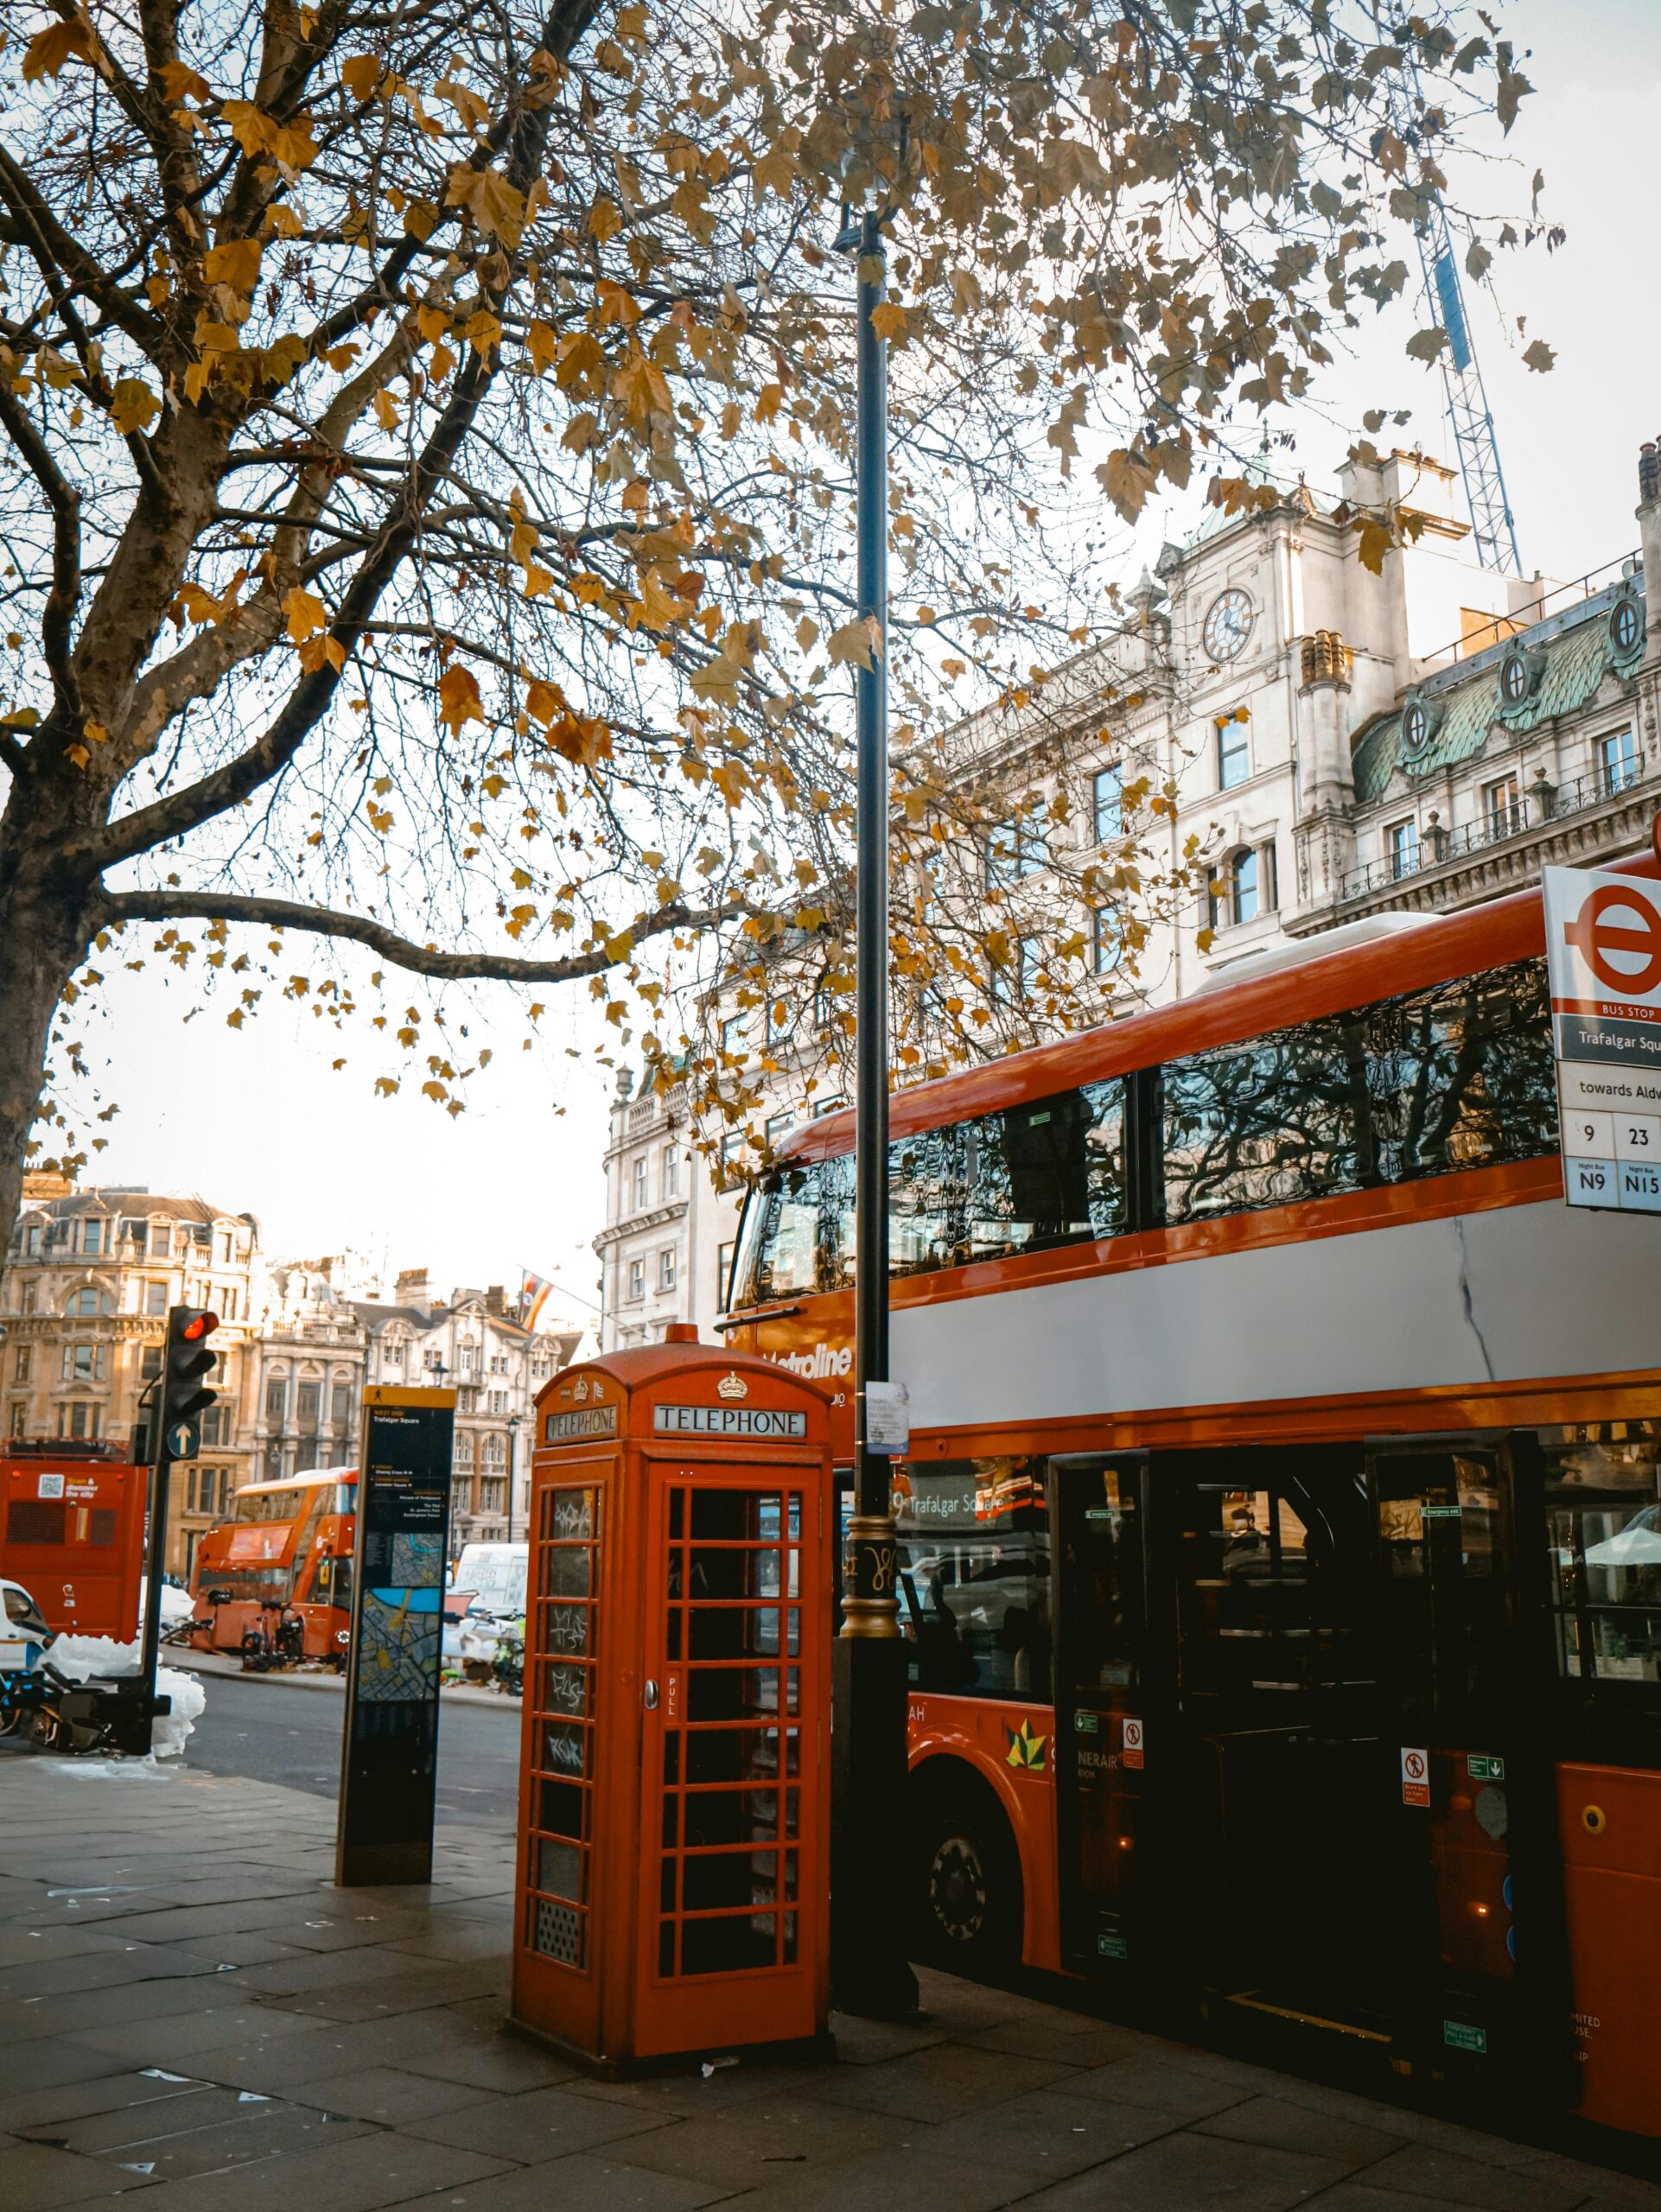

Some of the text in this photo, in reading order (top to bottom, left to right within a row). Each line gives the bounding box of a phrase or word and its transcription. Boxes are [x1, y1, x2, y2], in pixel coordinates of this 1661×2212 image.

[1602, 1004, 1655, 1019] BUS STOP
[1578, 1031, 1637, 1050] Trafalgar
[1580, 1081, 1632, 1097] towards
[1584, 1124, 1649, 1146] 9 23
[1580, 1172, 1659, 1194] N9 N15
[550, 1408, 616, 1438] TELEPHONE
[659, 1407, 800, 1435] TELEPHONE
[910, 1495, 959, 1518] Trafalgar
[963, 1494, 1004, 1516] Sqare
